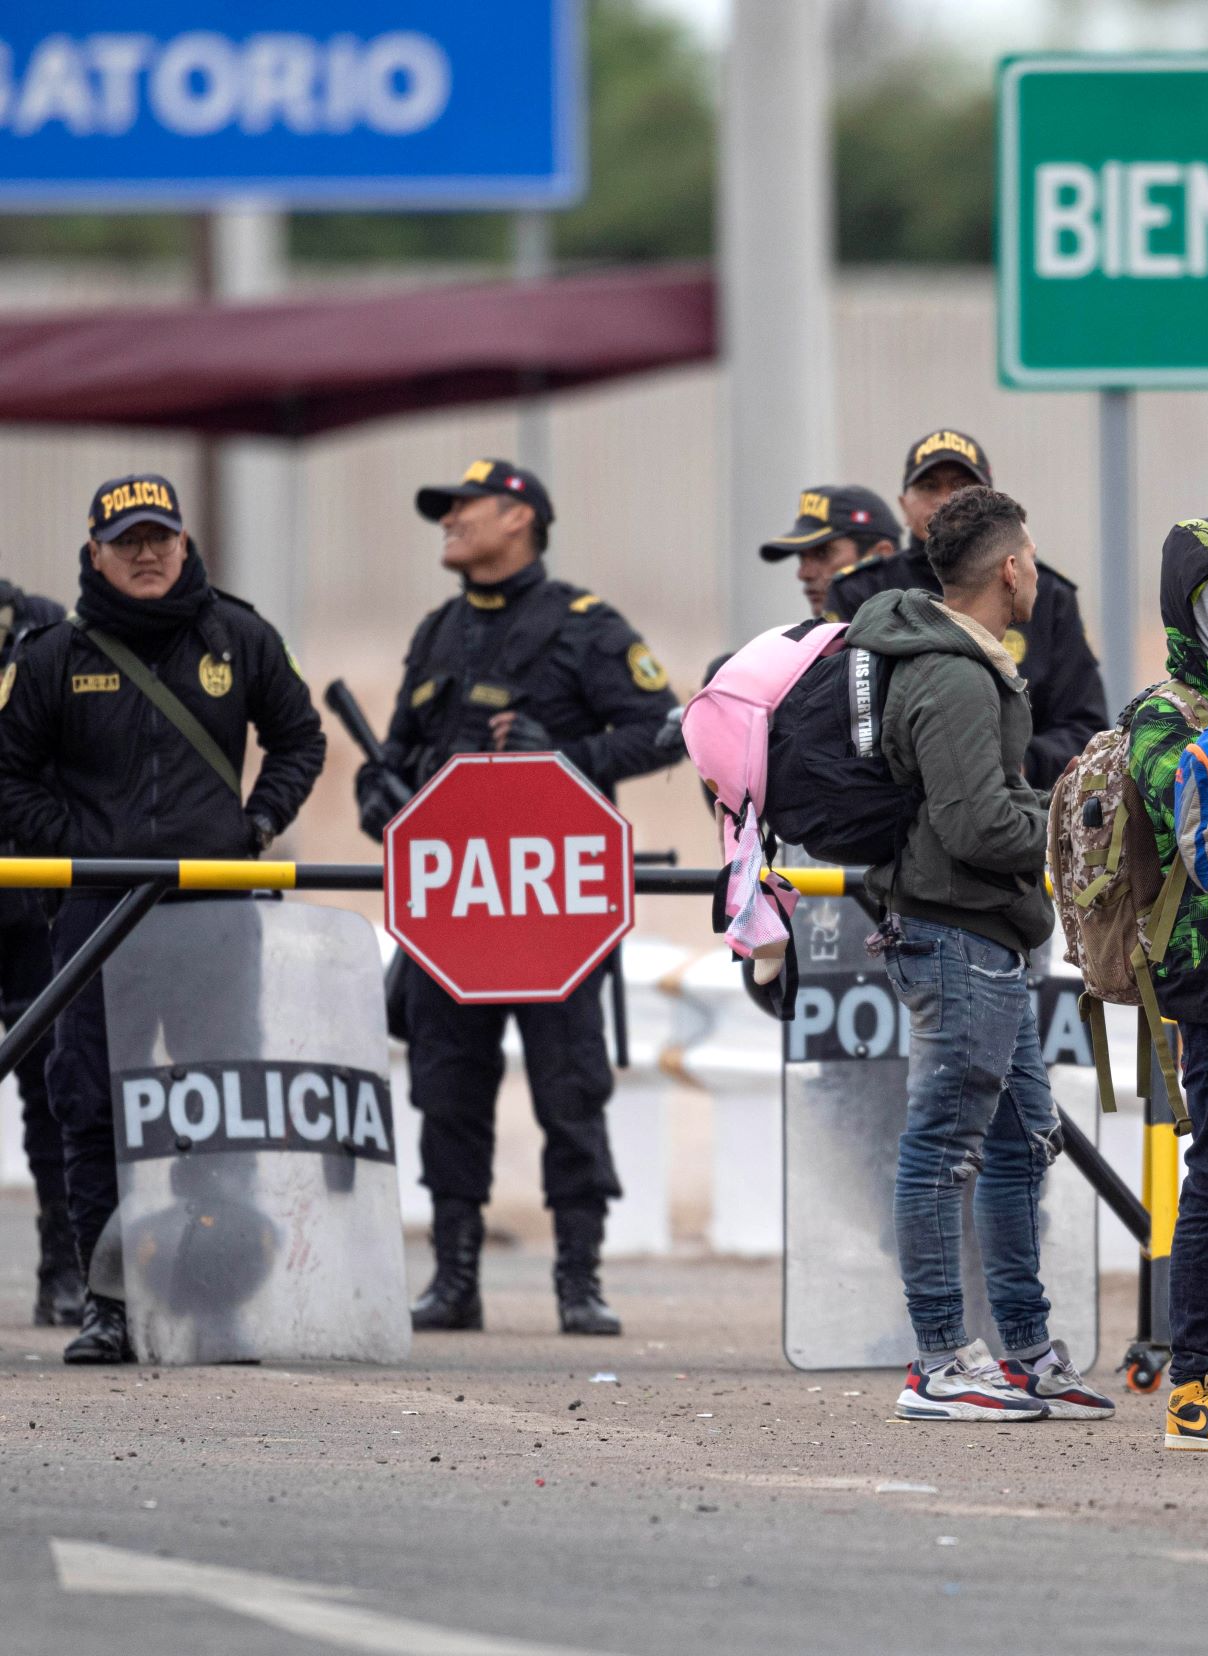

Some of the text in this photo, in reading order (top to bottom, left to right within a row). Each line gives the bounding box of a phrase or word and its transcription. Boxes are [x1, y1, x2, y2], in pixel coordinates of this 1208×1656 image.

[0, 32, 452, 136] ATORIO
[101, 481, 173, 519] POLICIA
[855, 663, 870, 678] IS
[405, 835, 609, 919] PARE
[122, 1070, 389, 1151] POLICIA
